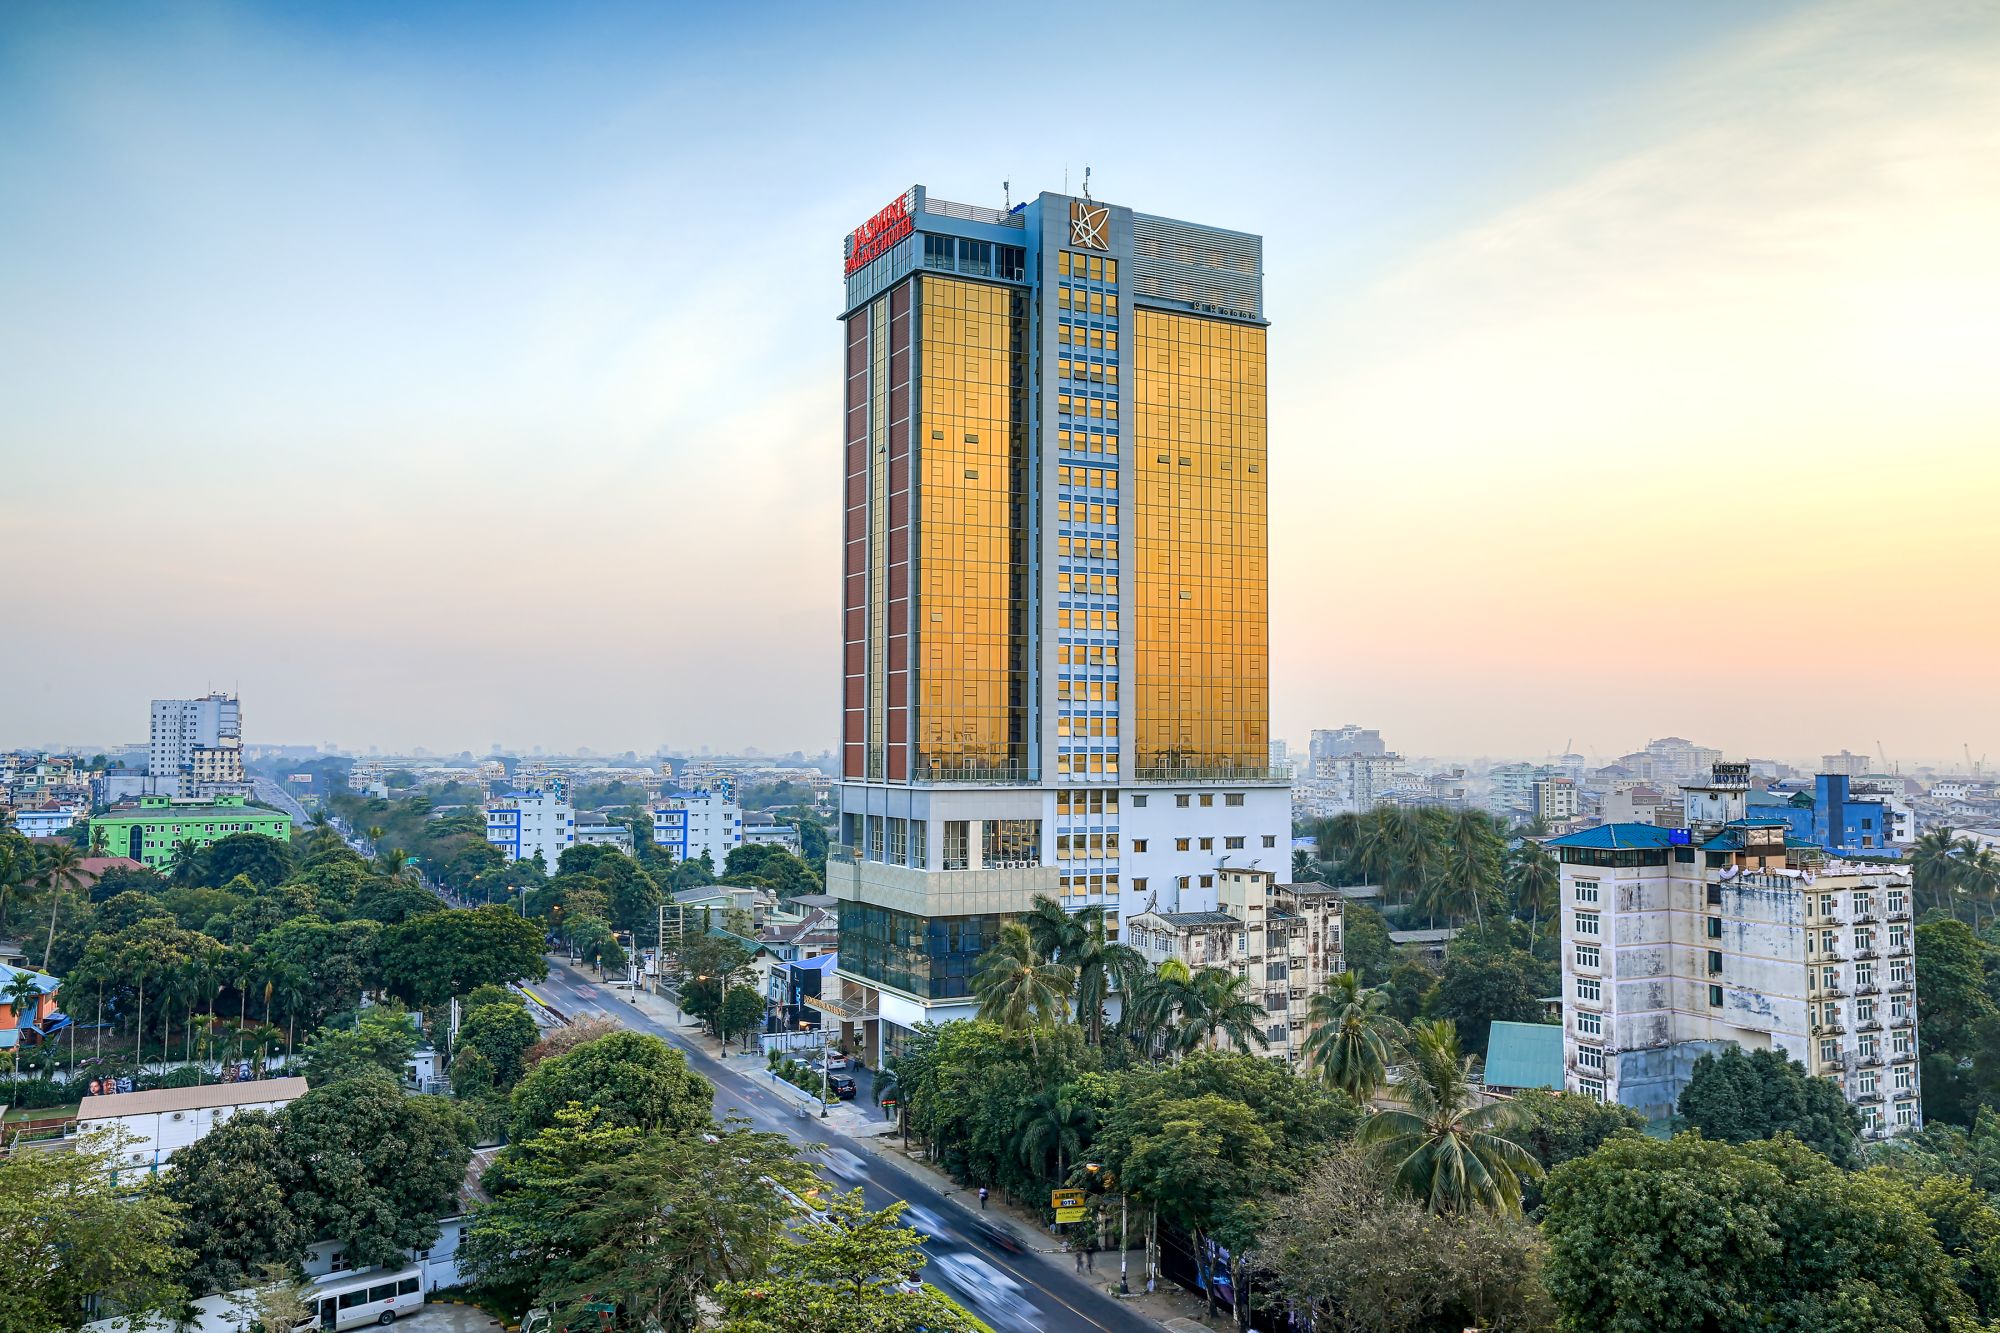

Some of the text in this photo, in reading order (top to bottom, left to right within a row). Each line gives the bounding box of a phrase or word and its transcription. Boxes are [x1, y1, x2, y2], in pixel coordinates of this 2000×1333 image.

[852, 193, 907, 254] JASMINE
[846, 216, 913, 273] PALACE HOTEL
[1712, 765, 1750, 774] LIBERTY
[1715, 775, 1749, 783] HOTEL
